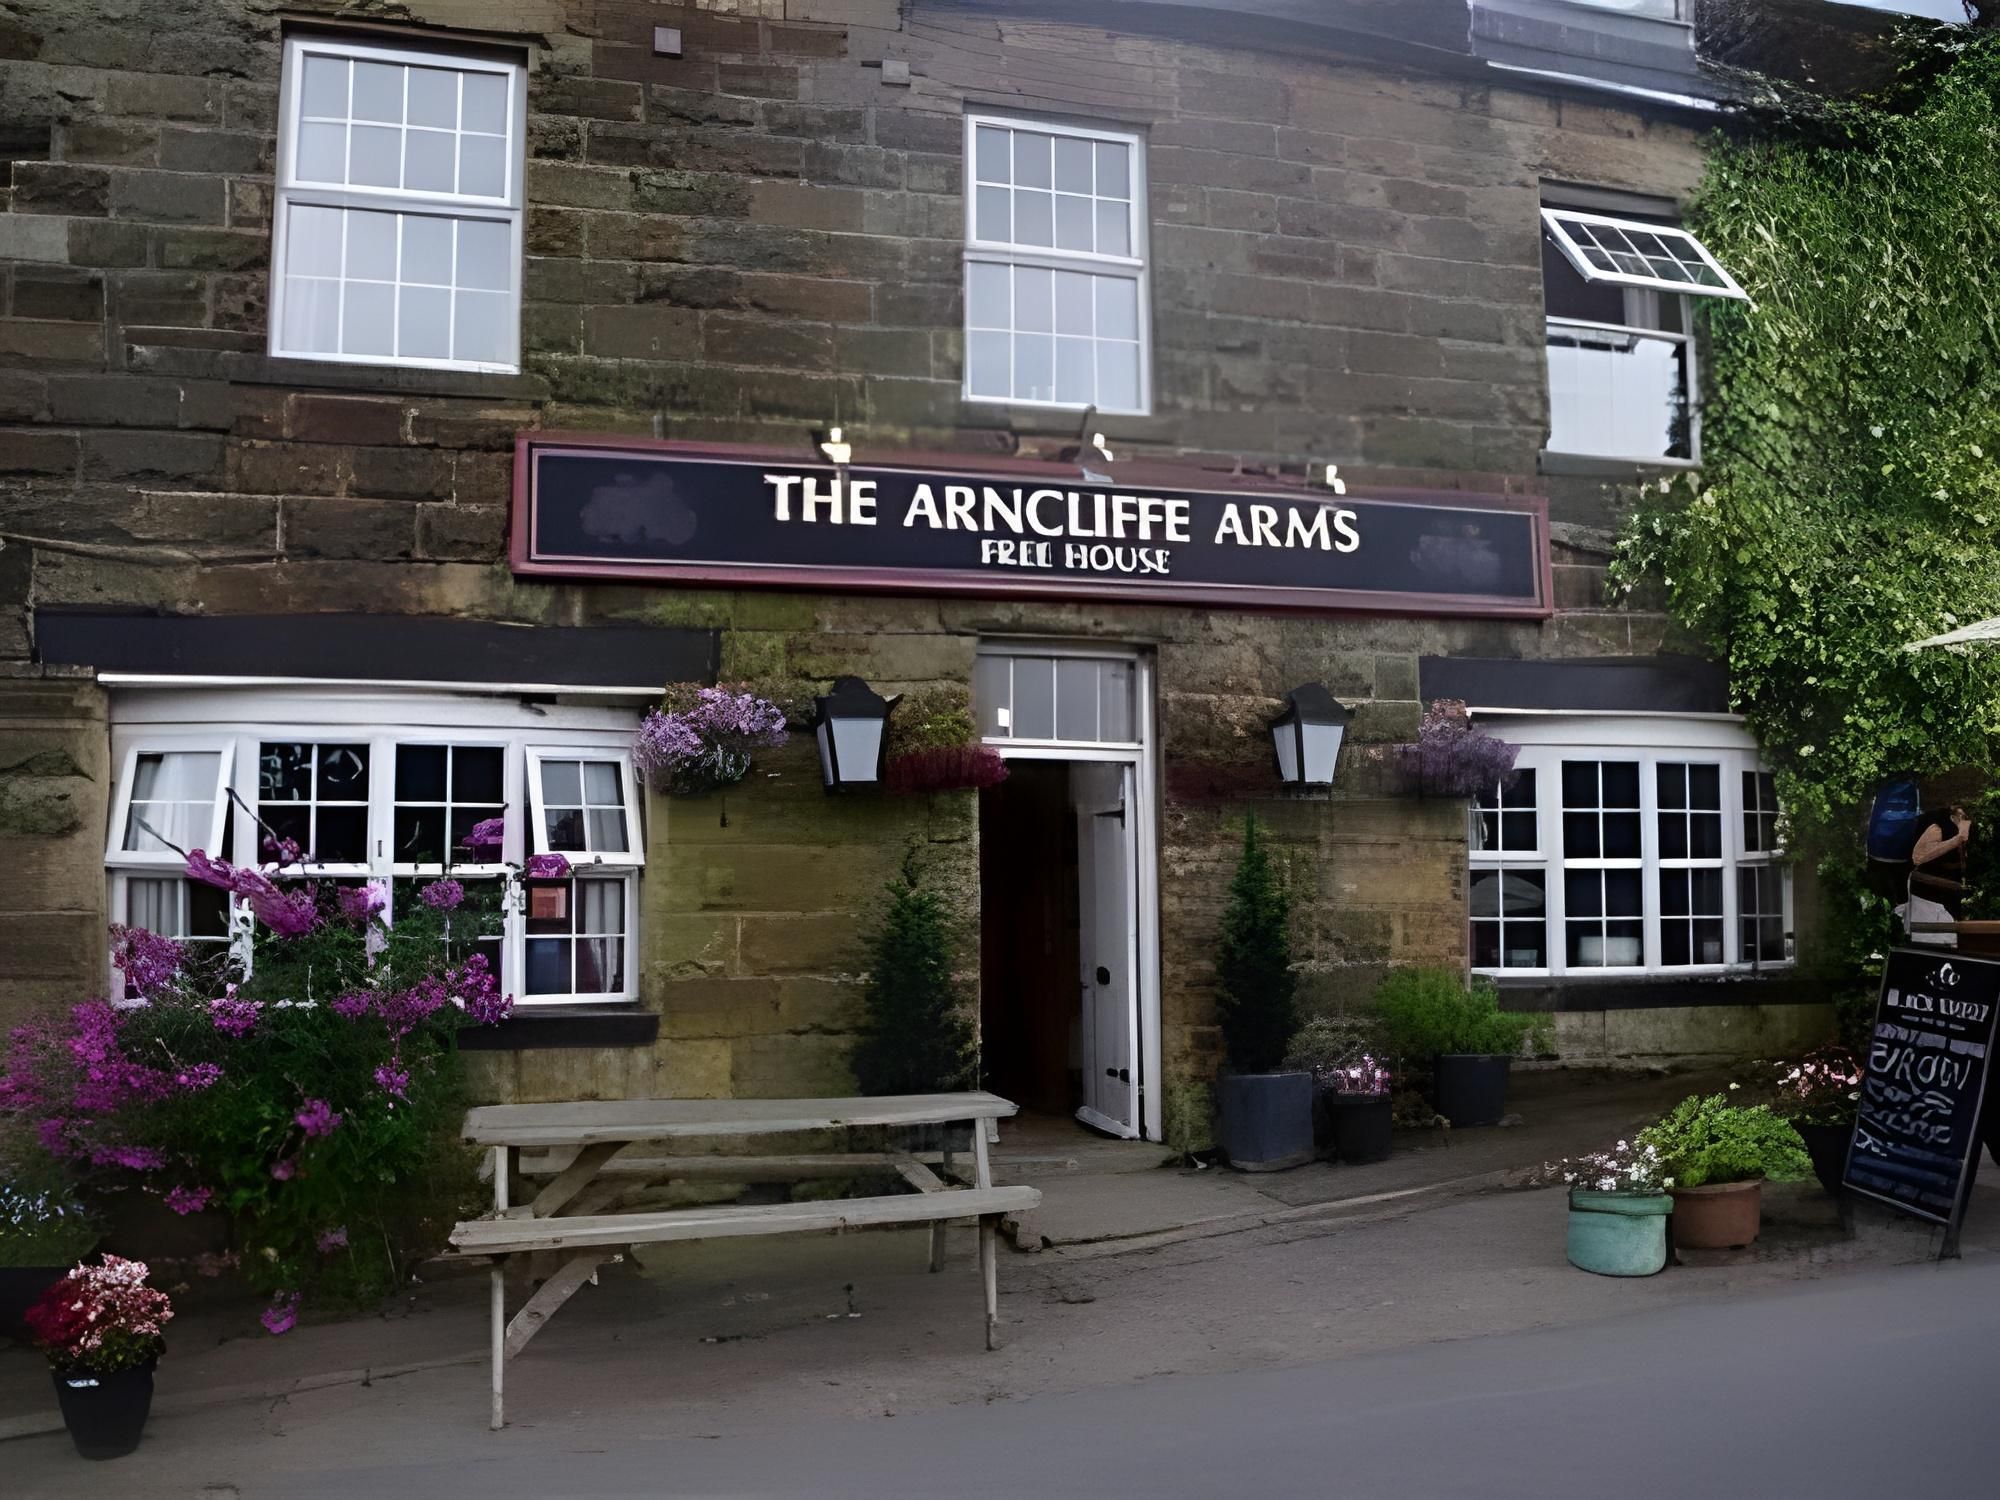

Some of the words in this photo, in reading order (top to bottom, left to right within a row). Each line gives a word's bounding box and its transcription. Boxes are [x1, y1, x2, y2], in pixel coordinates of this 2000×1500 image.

[763, 473, 878, 528] THE
[903, 482, 1191, 545] ARNCLIFFE
[1214, 502, 1361, 553] ARMS
[1064, 542, 1171, 574] HOUSE
